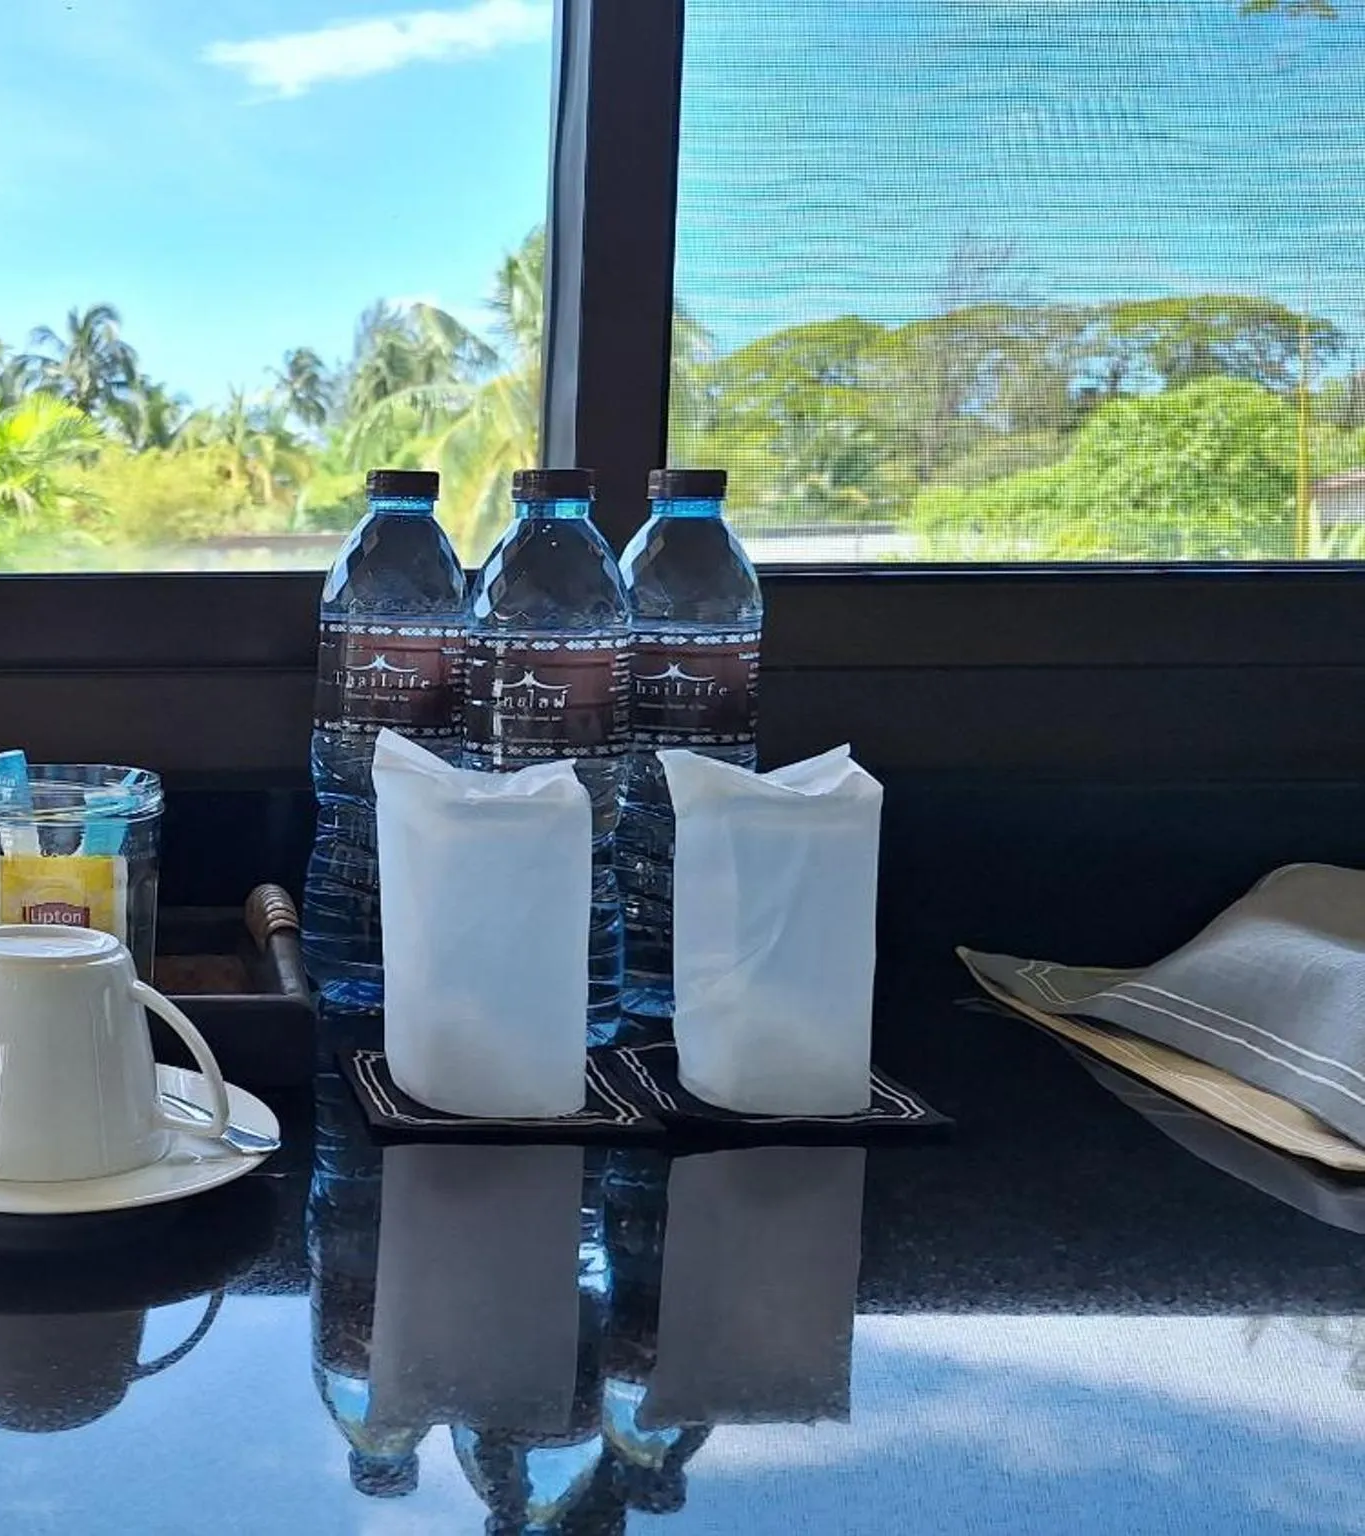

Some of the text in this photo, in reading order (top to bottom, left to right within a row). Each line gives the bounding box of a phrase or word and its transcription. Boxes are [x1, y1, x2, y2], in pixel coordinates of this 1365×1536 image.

[333, 669, 431, 689] ThaiLife
[636, 680, 729, 697] haiLife
[31, 908, 82, 925] Lipton
